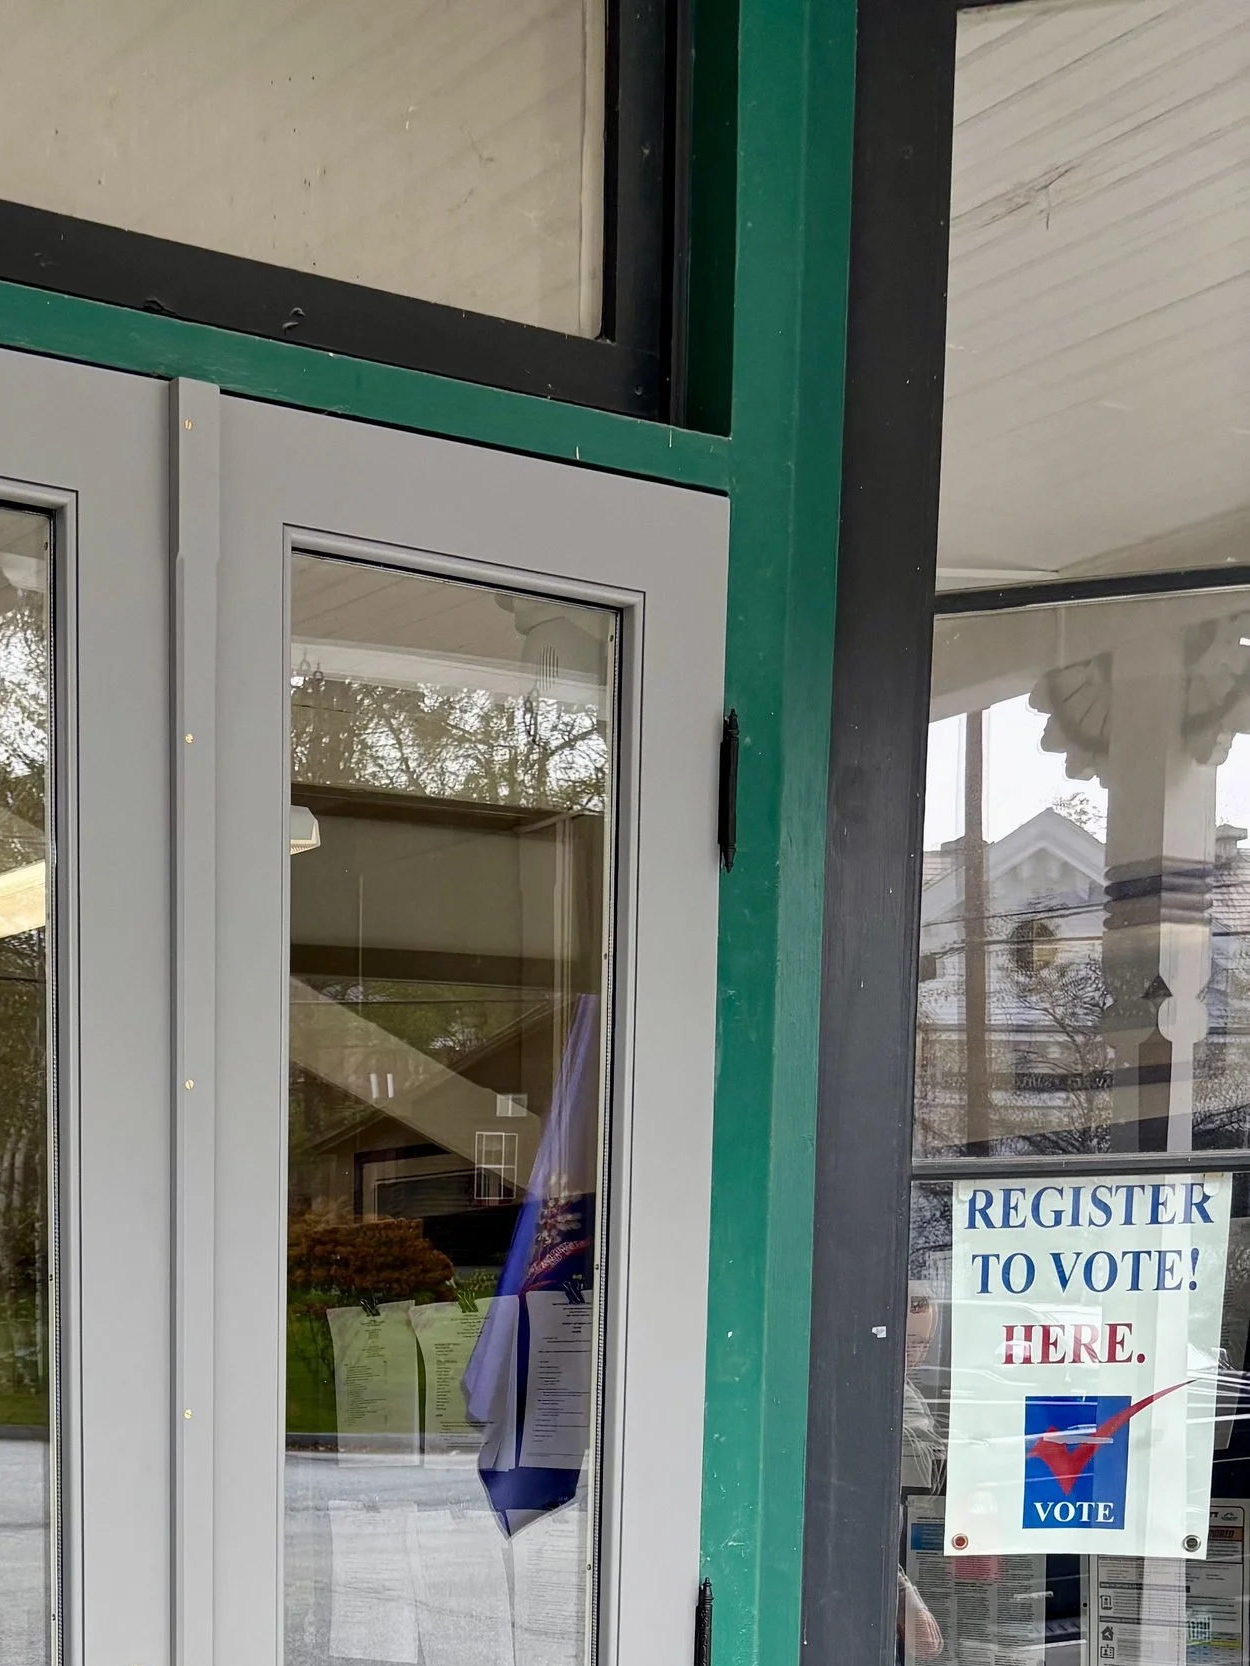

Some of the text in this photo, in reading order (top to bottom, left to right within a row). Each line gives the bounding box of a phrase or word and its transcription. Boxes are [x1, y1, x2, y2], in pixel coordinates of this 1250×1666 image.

[965, 1183, 1214, 1231] REGISTER
[972, 1248, 1199, 1294] TO VOTE!
[1003, 1323, 1146, 1366] HERE.
[1034, 1503, 1114, 1524] VOTE
